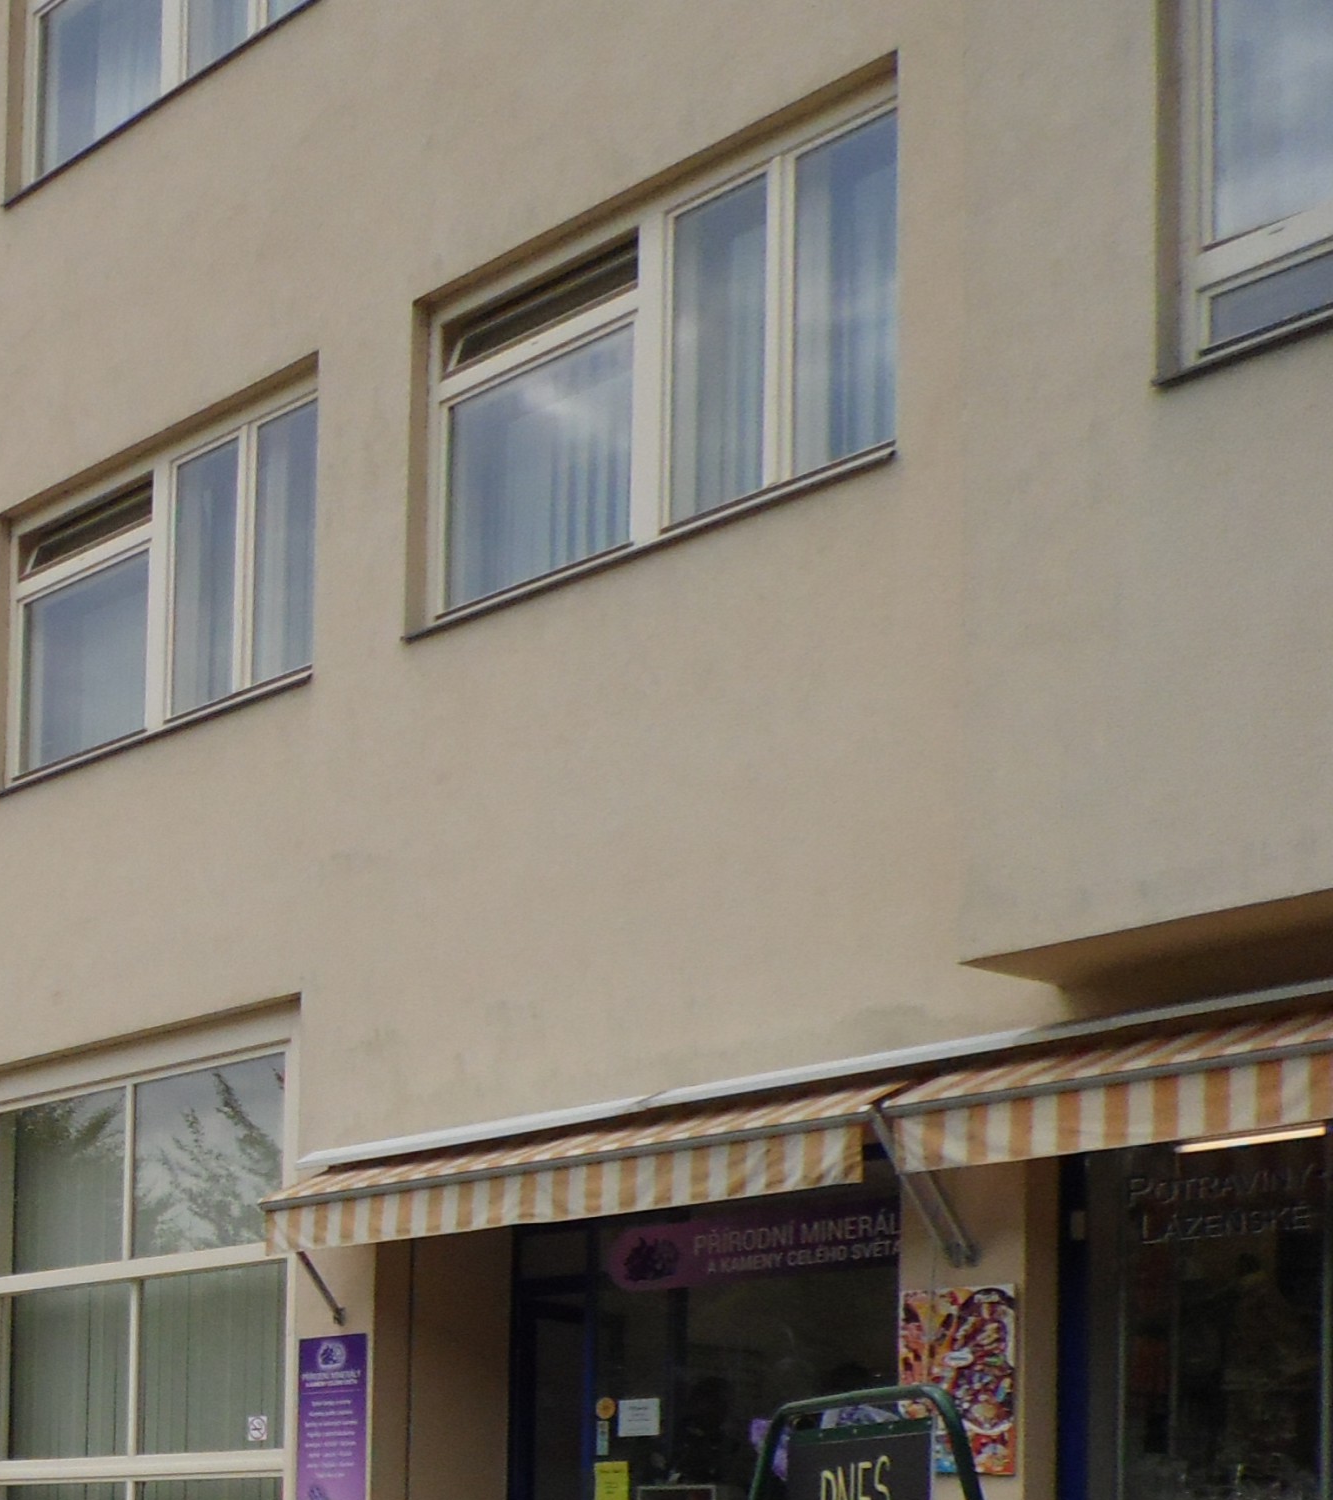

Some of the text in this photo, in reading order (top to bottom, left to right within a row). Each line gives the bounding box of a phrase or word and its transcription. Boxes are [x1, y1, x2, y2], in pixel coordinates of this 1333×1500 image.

[694, 1208, 902, 1256] PŘÍRODNÍ MINERÁL
[720, 1252, 784, 1274] KAMENY
[787, 1244, 847, 1266] CELÉHO
